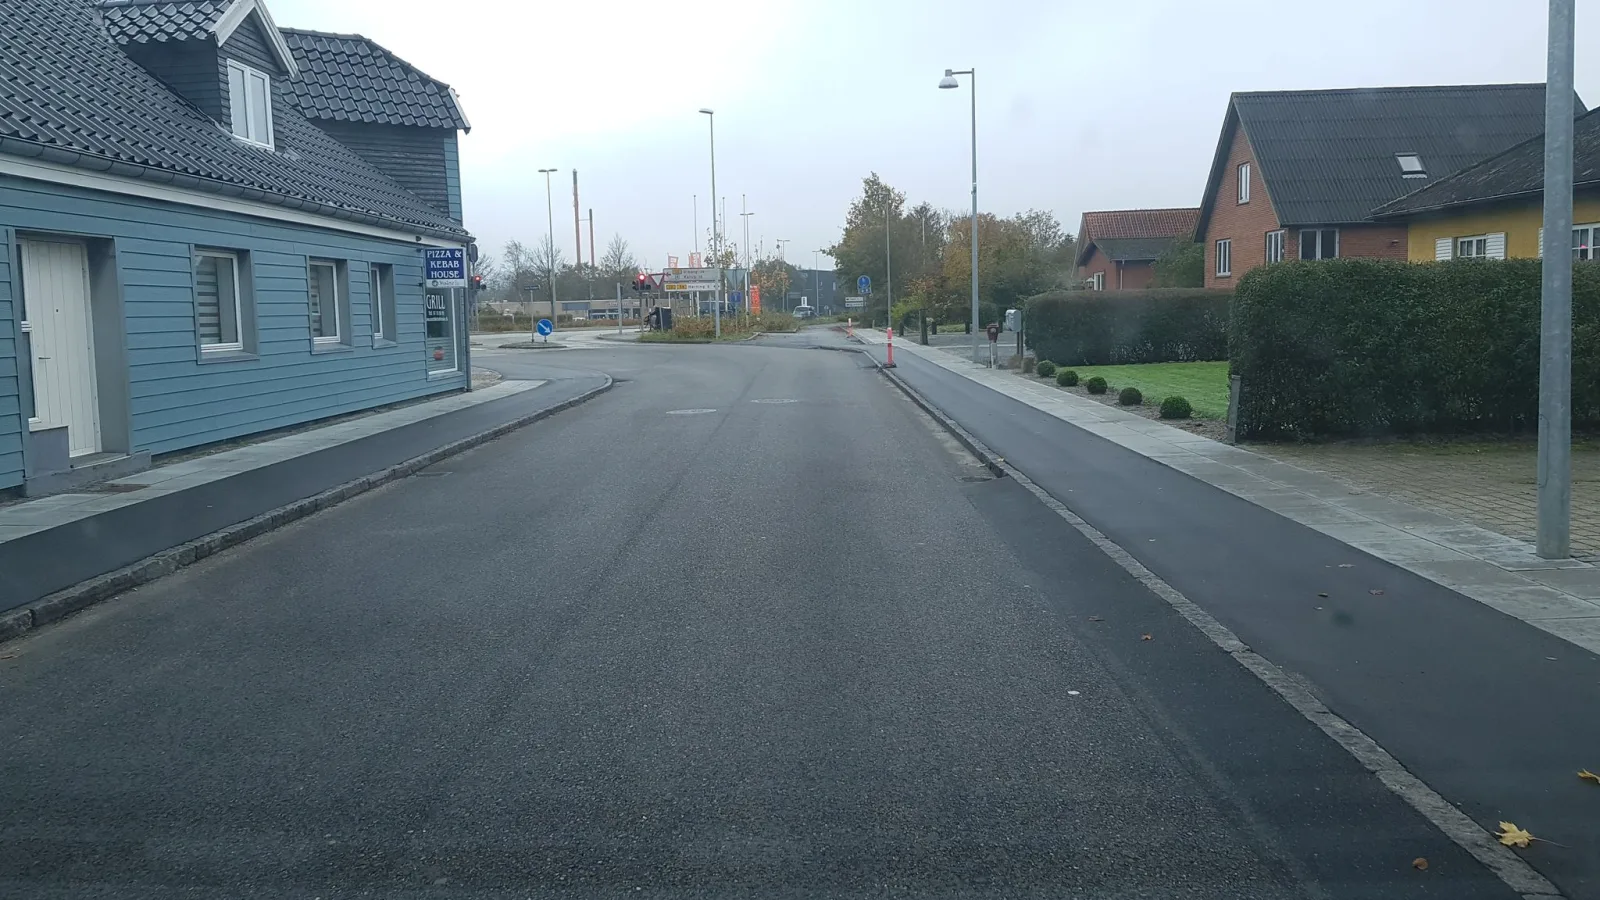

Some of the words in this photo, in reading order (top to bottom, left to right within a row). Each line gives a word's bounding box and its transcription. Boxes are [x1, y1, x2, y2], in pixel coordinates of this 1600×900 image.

[427, 250, 452, 258] PIZZA
[454, 250, 462, 258] &
[430, 260, 460, 268] KEBAB
[431, 270, 460, 278] HOUSE
[426, 294, 446, 310] GRILL
